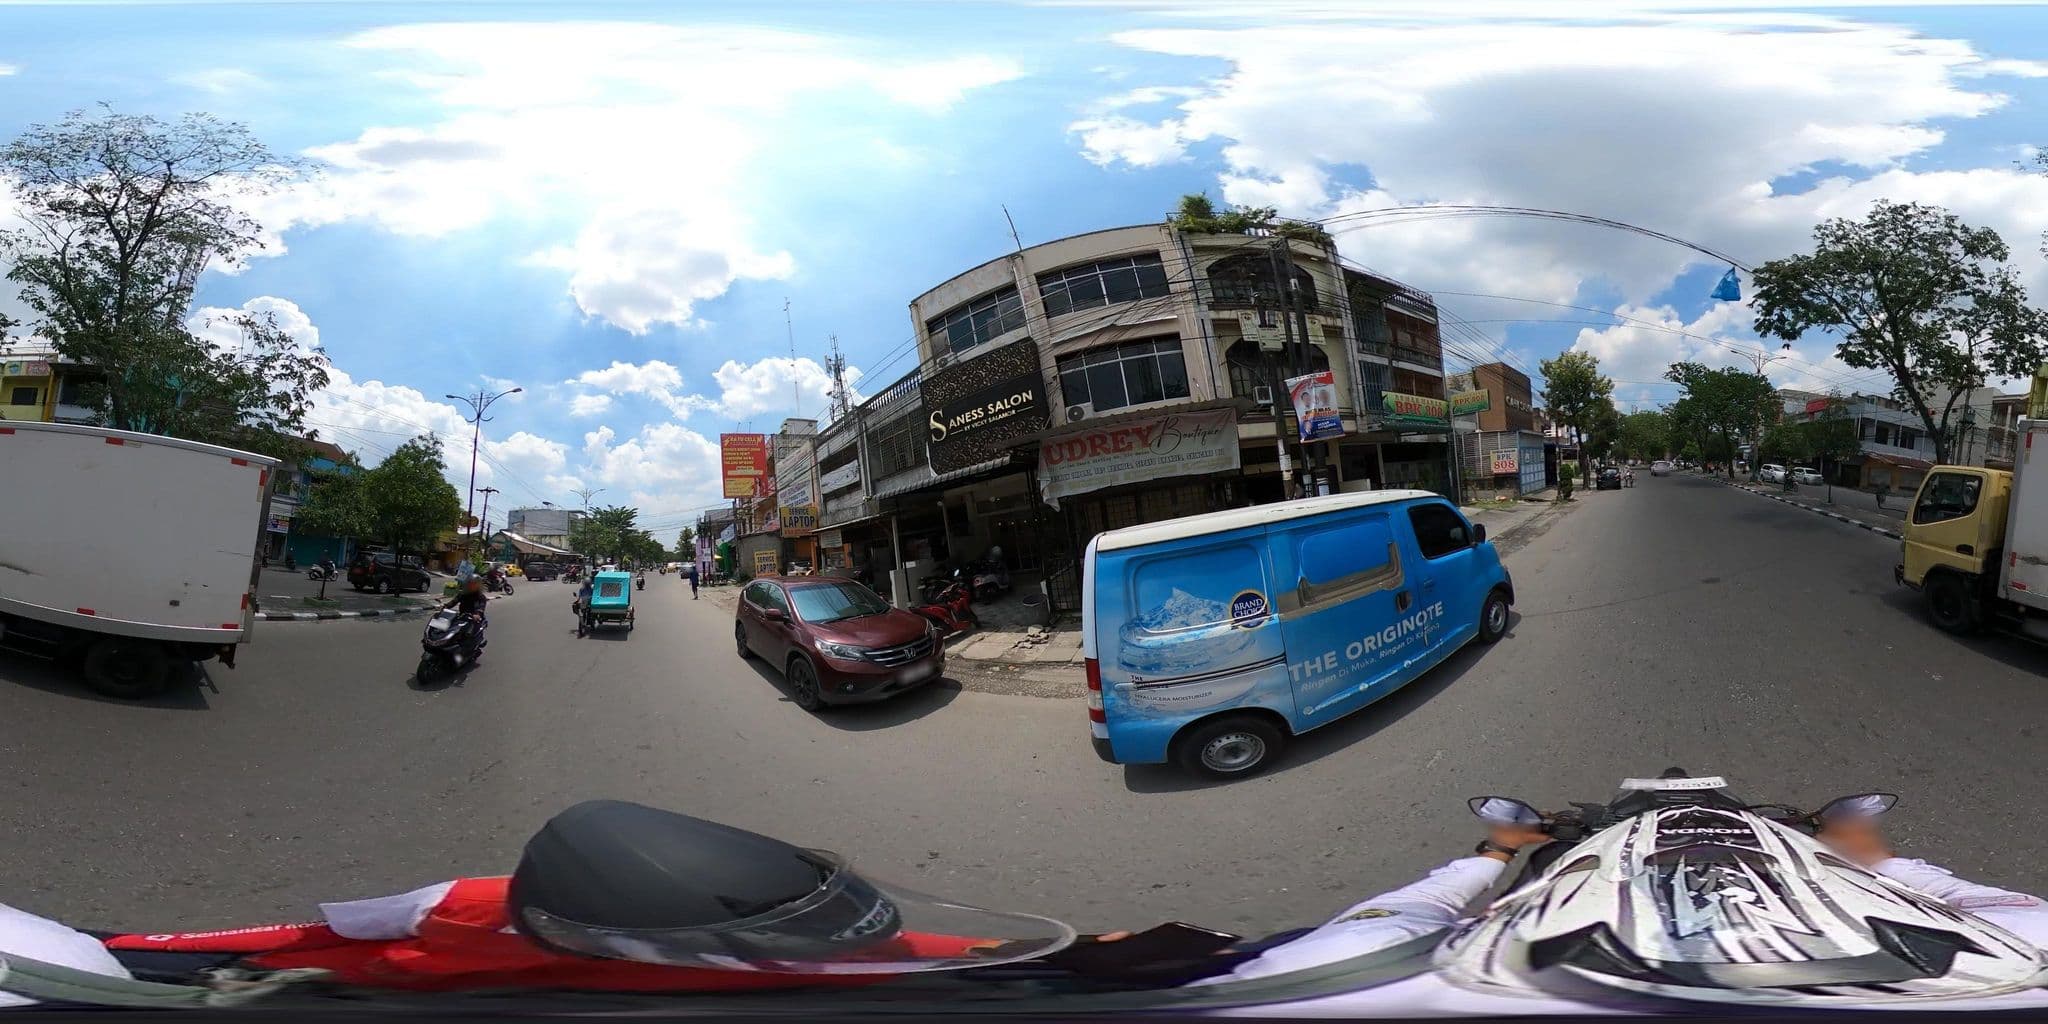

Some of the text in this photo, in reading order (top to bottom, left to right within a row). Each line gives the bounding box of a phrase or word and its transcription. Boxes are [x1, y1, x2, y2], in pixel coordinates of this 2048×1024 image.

[1395, 401, 1422, 416] BPK
[930, 390, 1033, 443] SANESS SALON
[1042, 425, 1152, 467] UDREY
[1494, 461, 1515, 470] 808
[783, 516, 815, 528] LAPTOP
[1234, 598, 1263, 611] BRAND
[1288, 601, 1444, 682] THE ORIGINOTE
